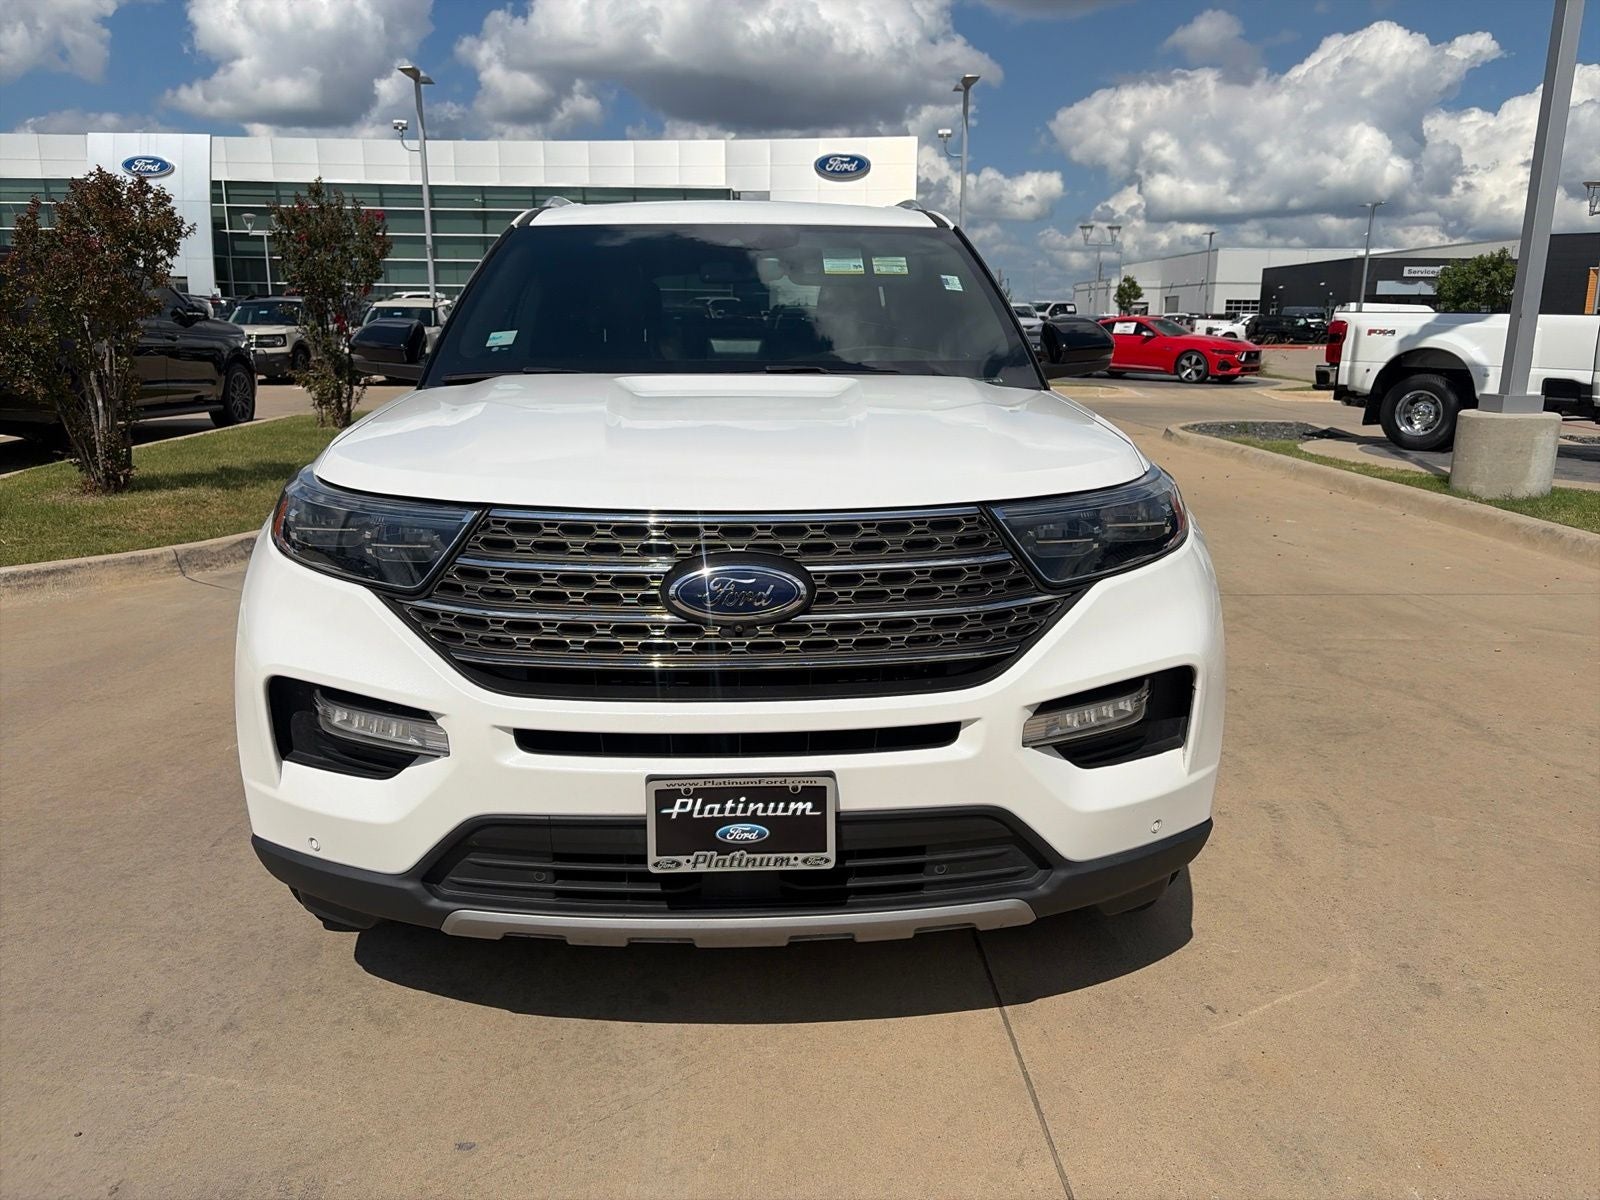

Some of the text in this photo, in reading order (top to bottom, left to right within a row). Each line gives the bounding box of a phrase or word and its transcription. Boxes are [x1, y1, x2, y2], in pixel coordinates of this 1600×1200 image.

[131, 158, 161, 171] Ford
[825, 156, 858, 171] Ford
[697, 576, 775, 607] Ford
[665, 778, 817, 788] www.PlatinumFord.com
[660, 796, 822, 820] Platinum
[726, 826, 759, 840] Ford
[657, 851, 827, 870] Ford Platinum Ford
